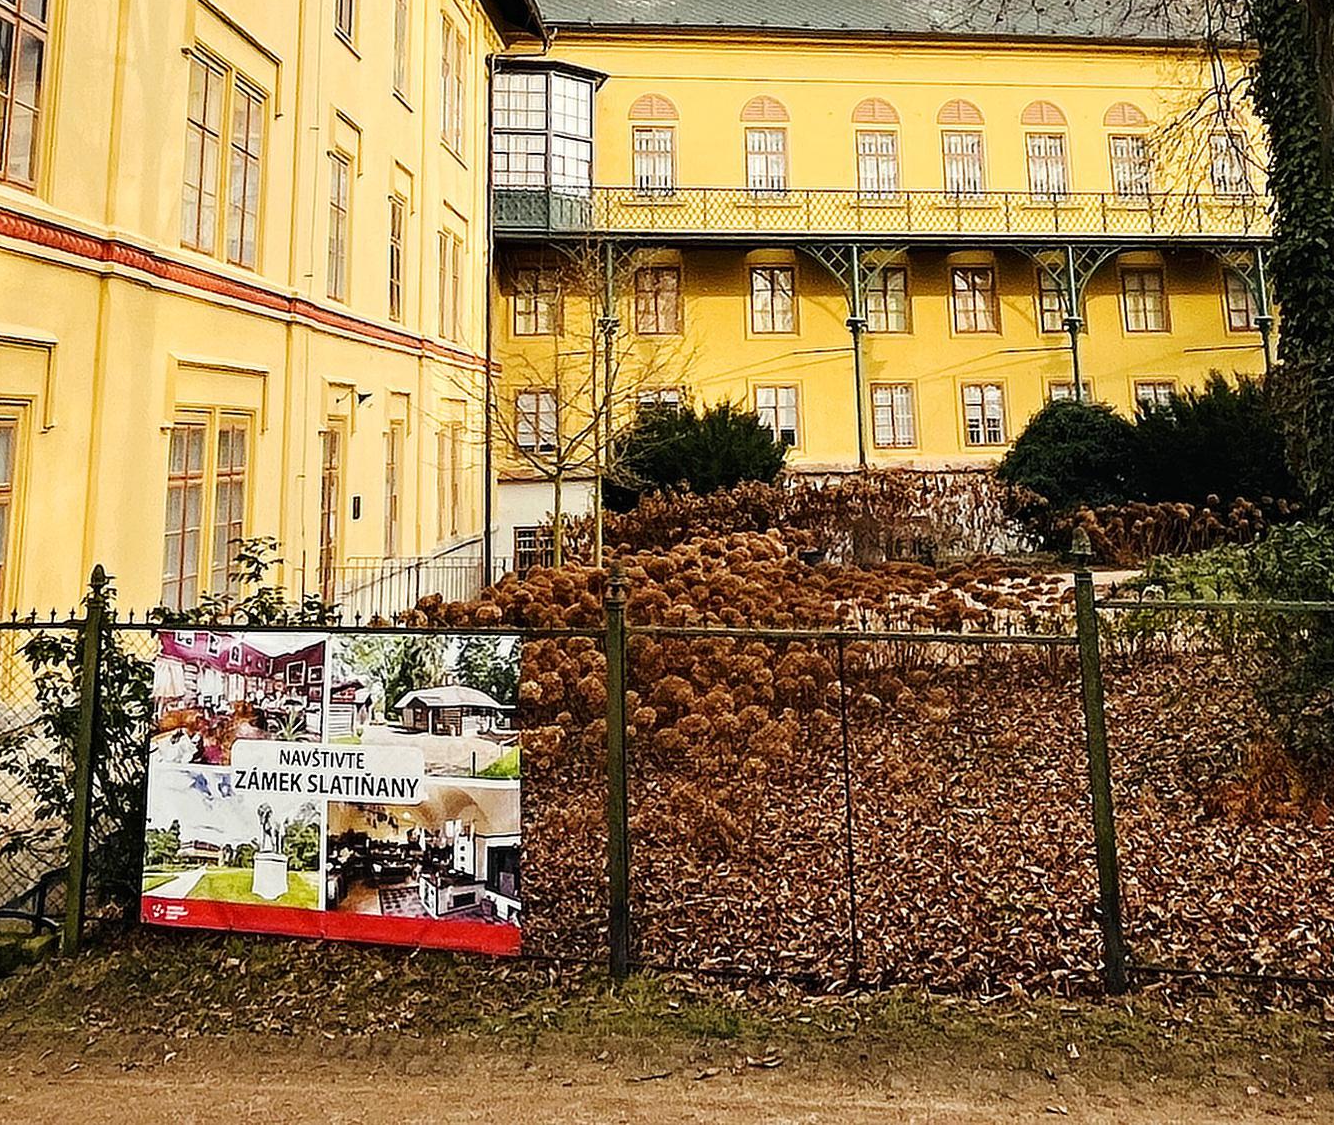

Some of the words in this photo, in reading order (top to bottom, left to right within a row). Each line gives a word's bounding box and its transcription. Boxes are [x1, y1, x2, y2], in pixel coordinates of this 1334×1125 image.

[279, 747, 365, 769] NAVŠTIVTE
[234, 767, 302, 793] ZÁMEK
[307, 773, 419, 798] SLATIŇANY
